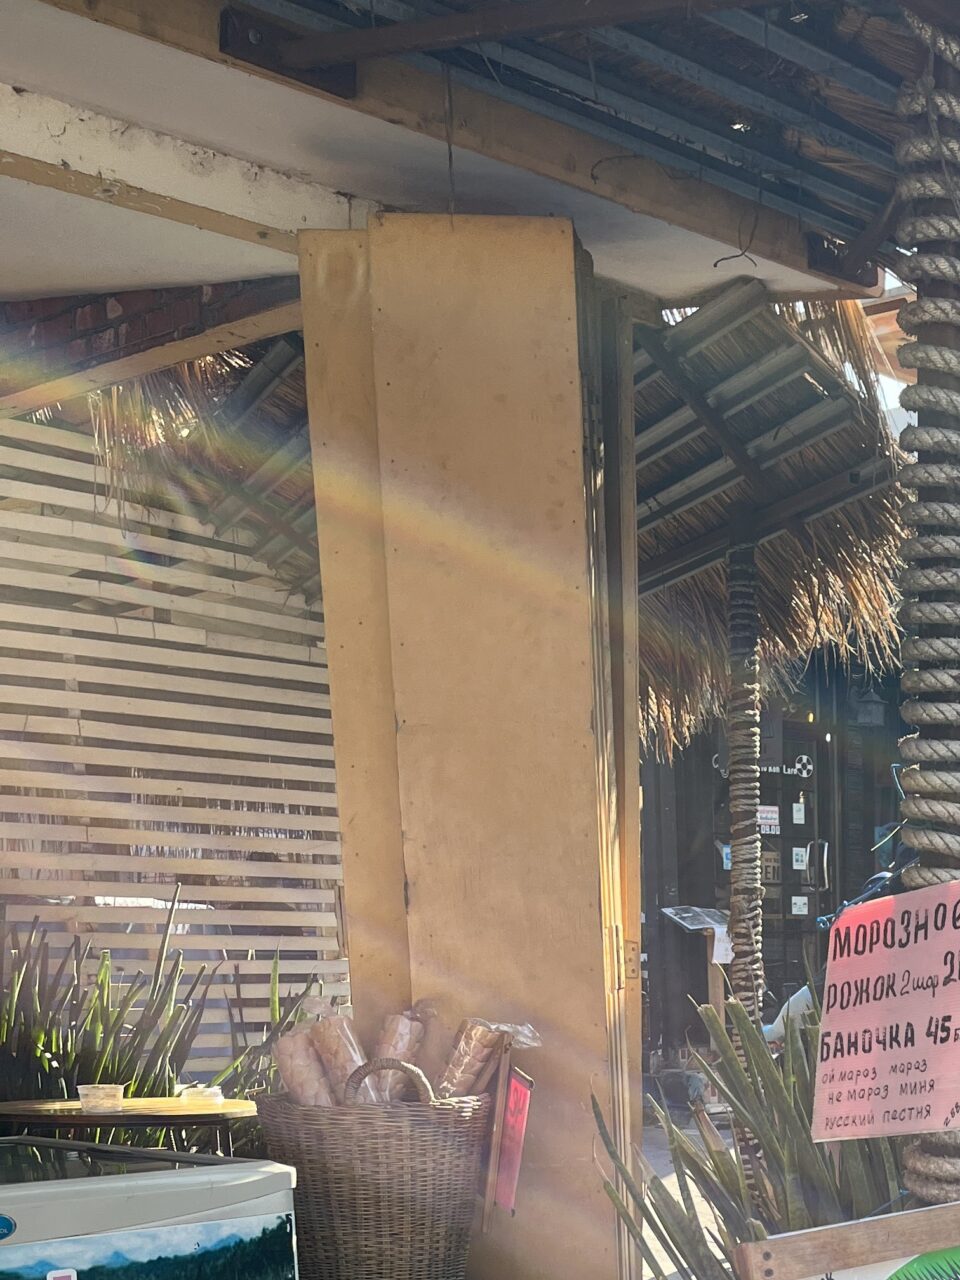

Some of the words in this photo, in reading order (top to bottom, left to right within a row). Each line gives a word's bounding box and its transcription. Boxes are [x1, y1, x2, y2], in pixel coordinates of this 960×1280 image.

[827, 972, 897, 1014] РОЖОК
[820, 1022, 915, 1062] БАНОЧКА
[926, 1015, 952, 1045] 45
